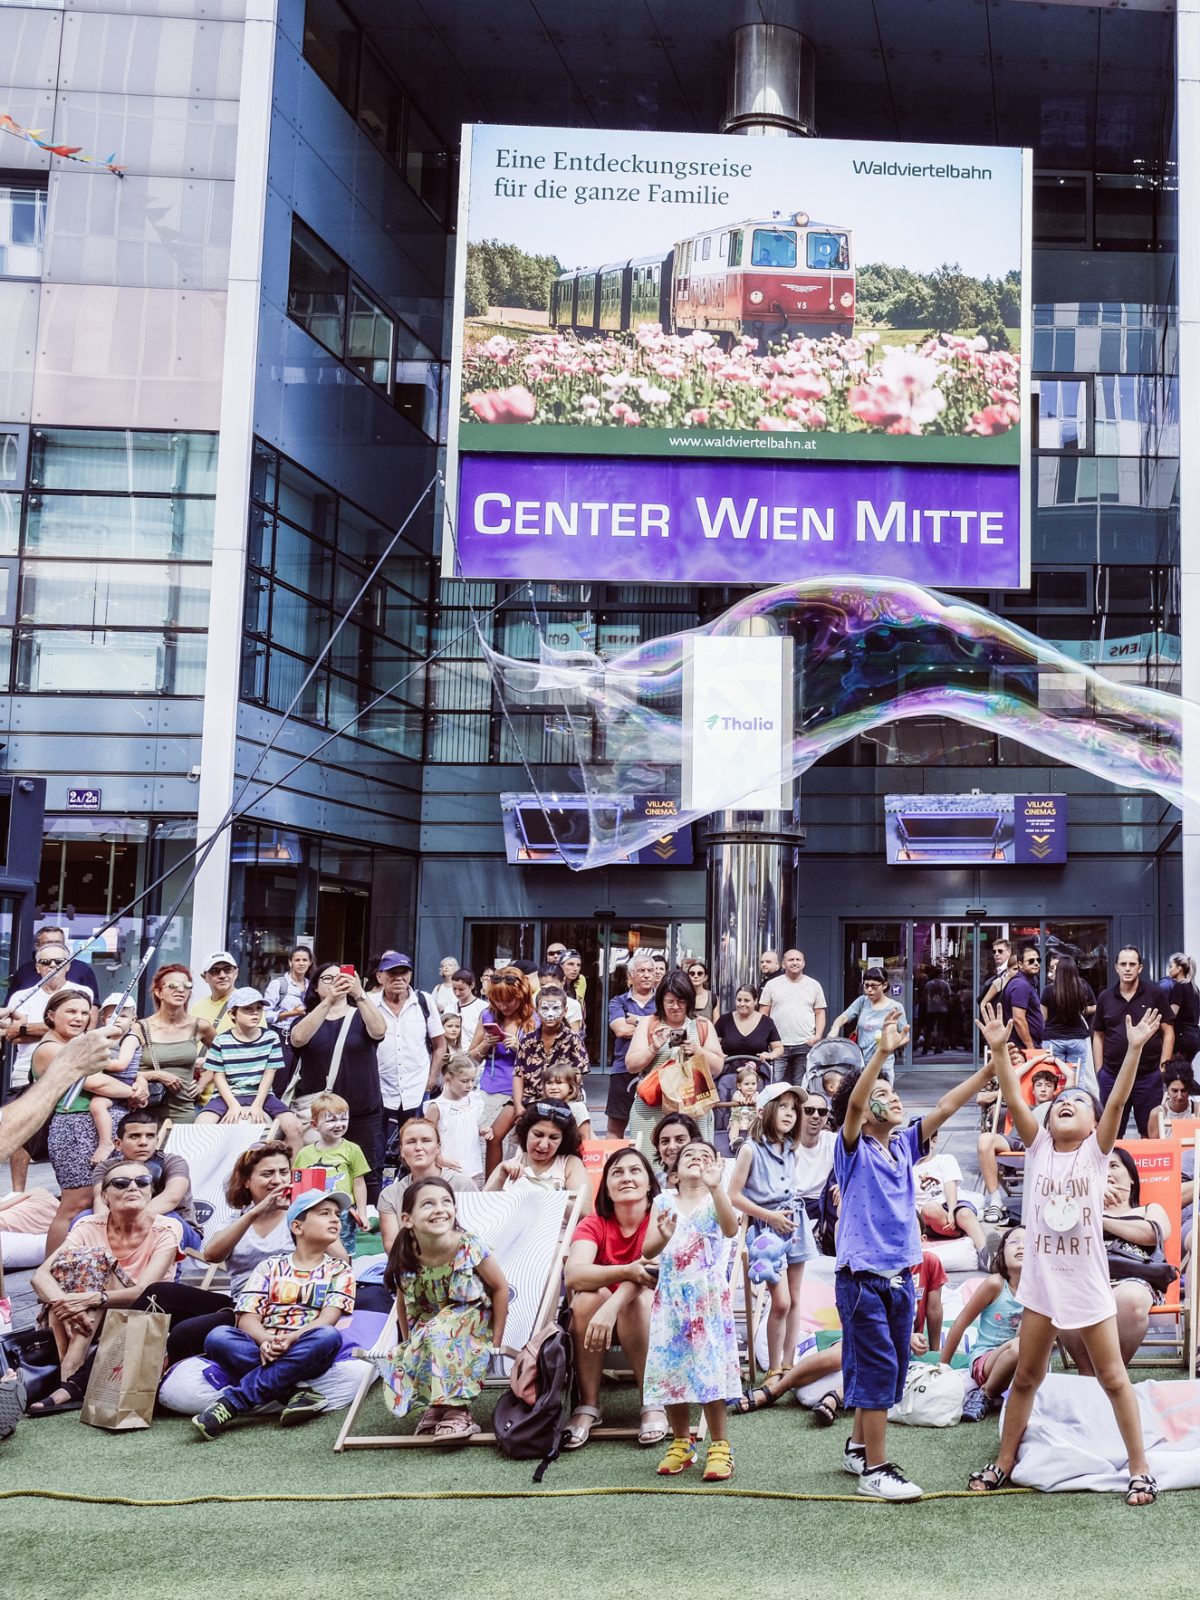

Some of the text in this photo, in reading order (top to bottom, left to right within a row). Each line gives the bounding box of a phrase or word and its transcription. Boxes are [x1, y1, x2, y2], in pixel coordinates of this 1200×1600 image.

[495, 149, 752, 179] Eine Entdeckungsreise
[852, 160, 992, 180] Waldviertelbahn
[494, 177, 730, 206] für die ganze Familie
[669, 436, 817, 450] www.waldviertelbahn.at
[474, 491, 1004, 545] CENTER WIEN MITTE
[721, 717, 774, 730] Thalia
[645, 808, 678, 816] CINEMAS
[1024, 808, 1057, 816] CINEMAS
[583, 1153, 600, 1162] DIO
[1135, 1157, 1171, 1168] HEUTE
[1035, 1204, 1091, 1227] YR
[1034, 1234, 1092, 1256] HEART
[271, 1281, 328, 1308] LOVE
